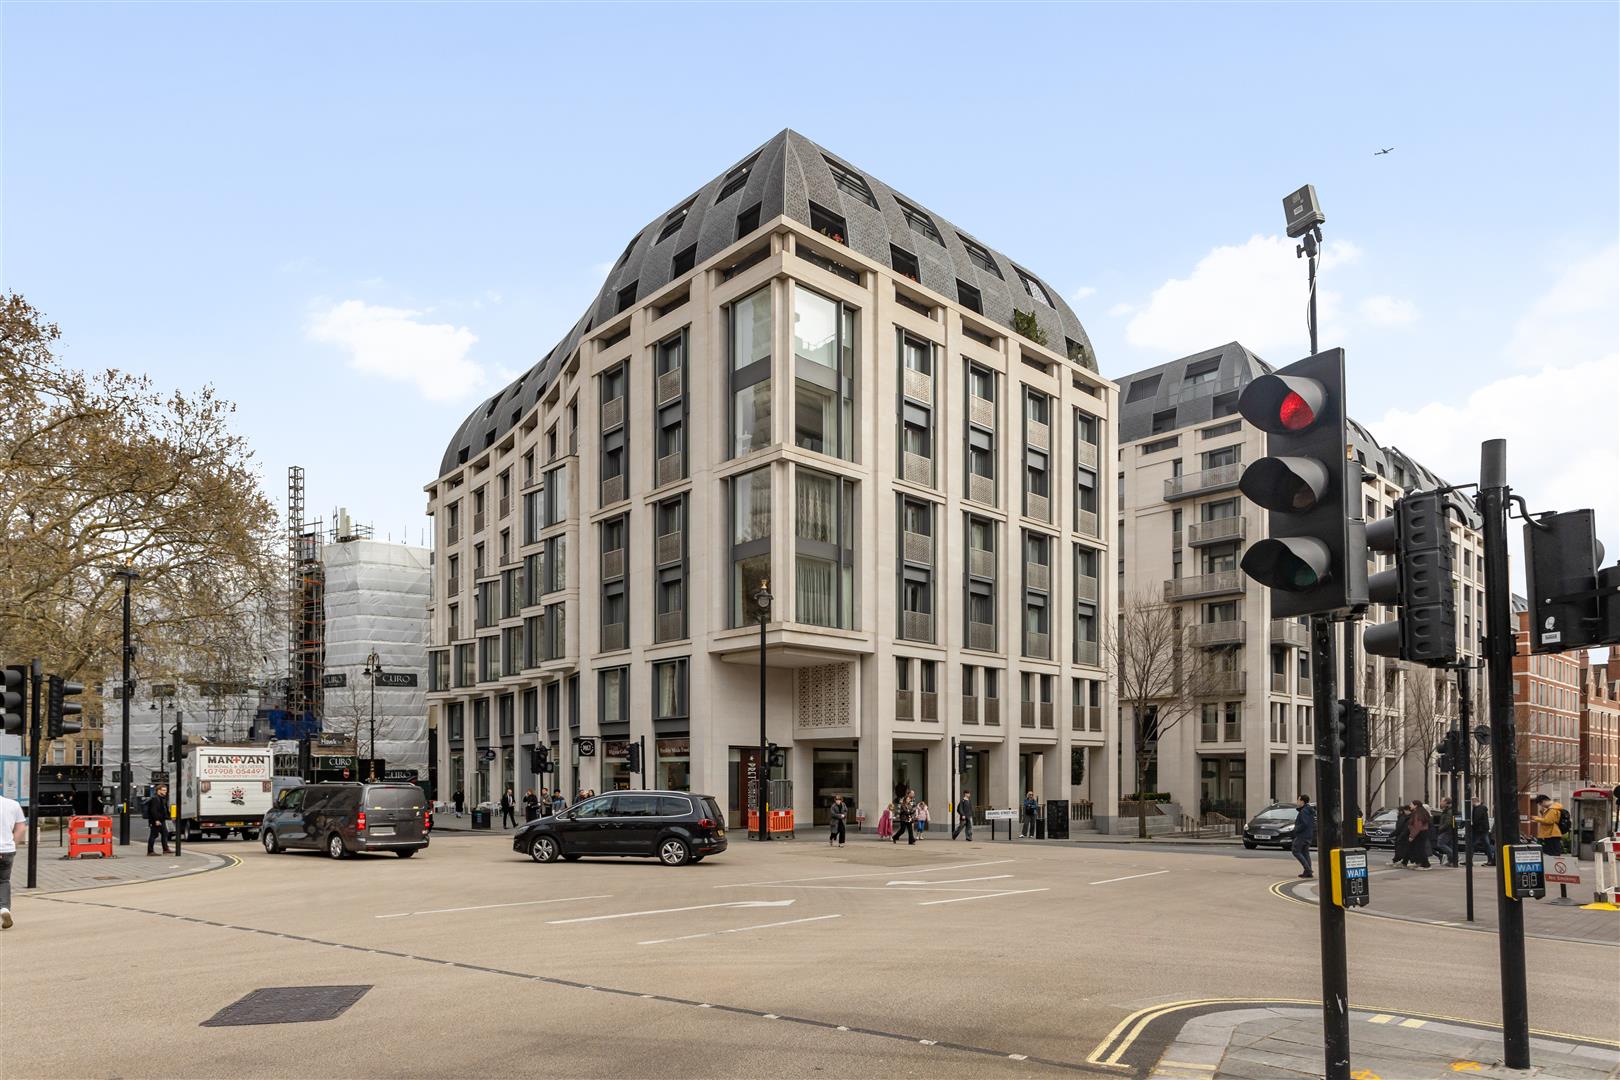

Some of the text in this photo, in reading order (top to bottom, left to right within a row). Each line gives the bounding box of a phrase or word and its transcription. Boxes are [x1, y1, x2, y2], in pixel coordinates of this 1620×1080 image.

[382, 674, 410, 684] CURO
[329, 758, 352, 766] CURO
[1516, 863, 1540, 872] WAIT
[1347, 868, 1365, 878] WAIT
